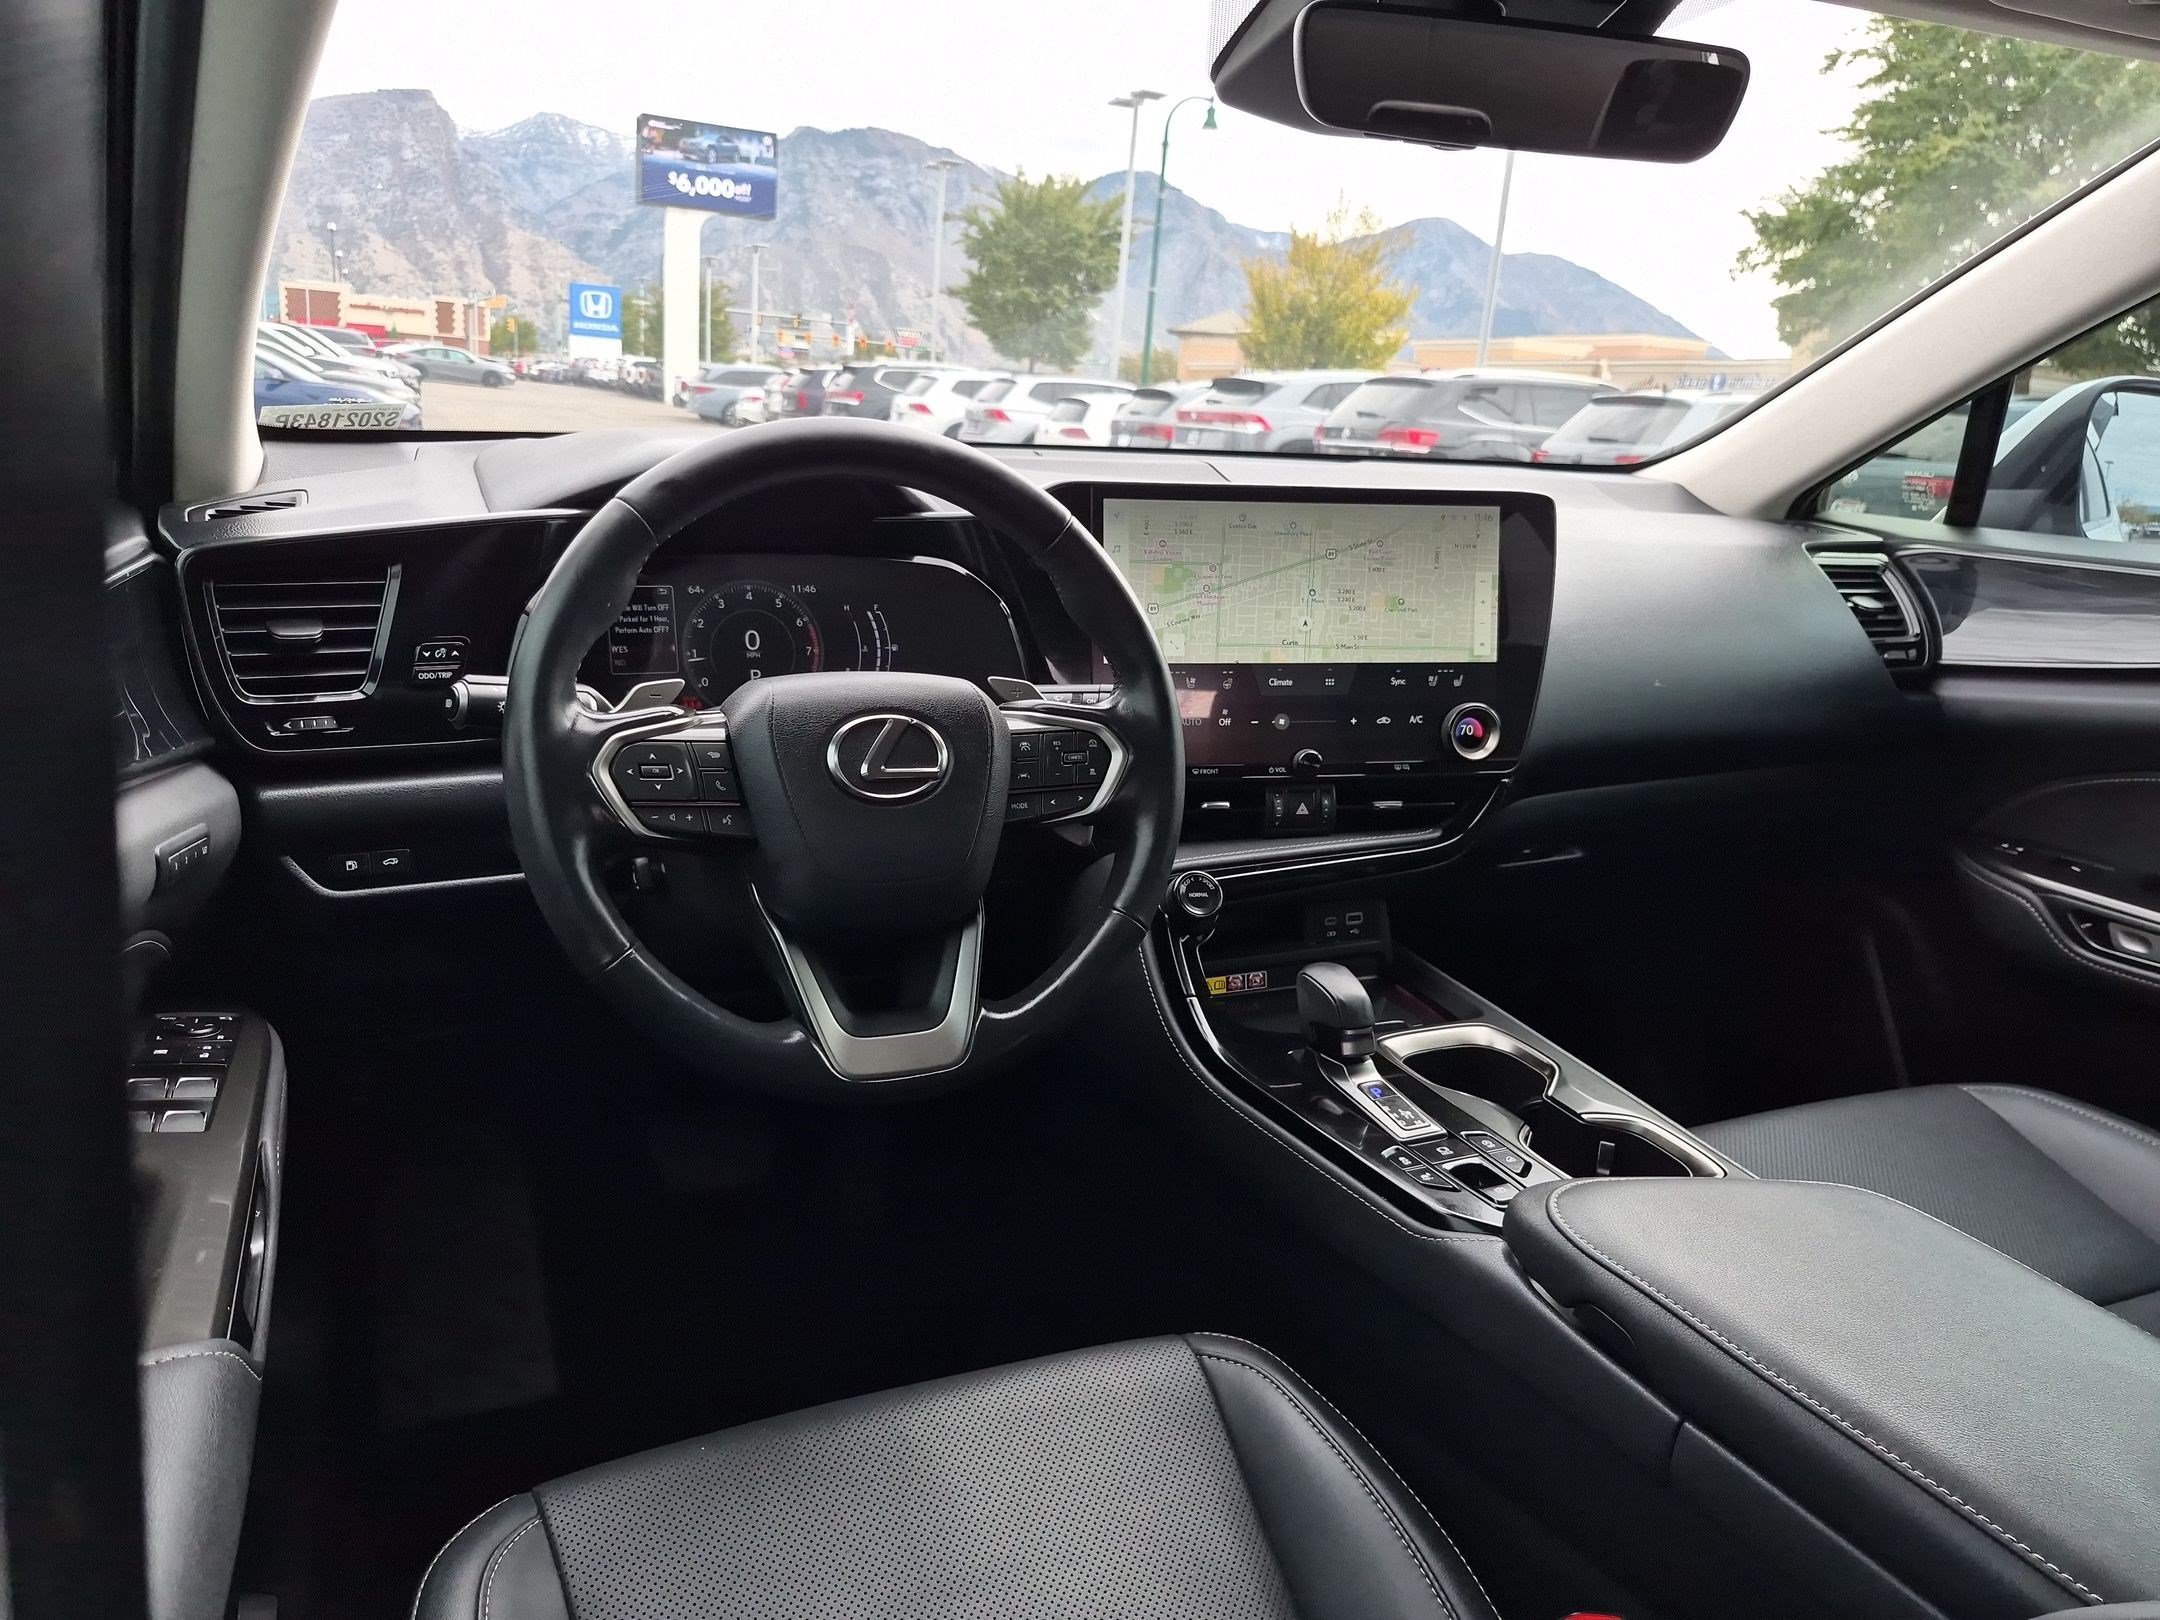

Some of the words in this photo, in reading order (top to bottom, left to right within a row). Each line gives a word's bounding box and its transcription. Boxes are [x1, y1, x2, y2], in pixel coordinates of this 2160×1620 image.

[668, 170, 734, 198] $6,000
[572, 321, 619, 332] HONDA
[1474, 513, 1493, 521] 11:46
[791, 585, 816, 593] 11:46
[745, 592, 752, 600] 4
[718, 599, 725, 608] 3
[775, 599, 782, 608] 5
[697, 619, 704, 628] 2
[796, 618, 803, 627] 6
[744, 629, 760, 651] 0
[691, 649, 697, 658] 1
[806, 647, 812, 656] 7
[418, 671, 453, 680] ODO/TRIP
[750, 669, 761, 681] P
[701, 678, 709, 687] 0
[1269, 678, 1293, 686] Climate
[1390, 677, 1406, 687] Sync
[1219, 718, 1231, 727] Off
[1409, 715, 1423, 724] A/C
[1460, 724, 1474, 736] 70
[1370, 1087, 1382, 1097] P
